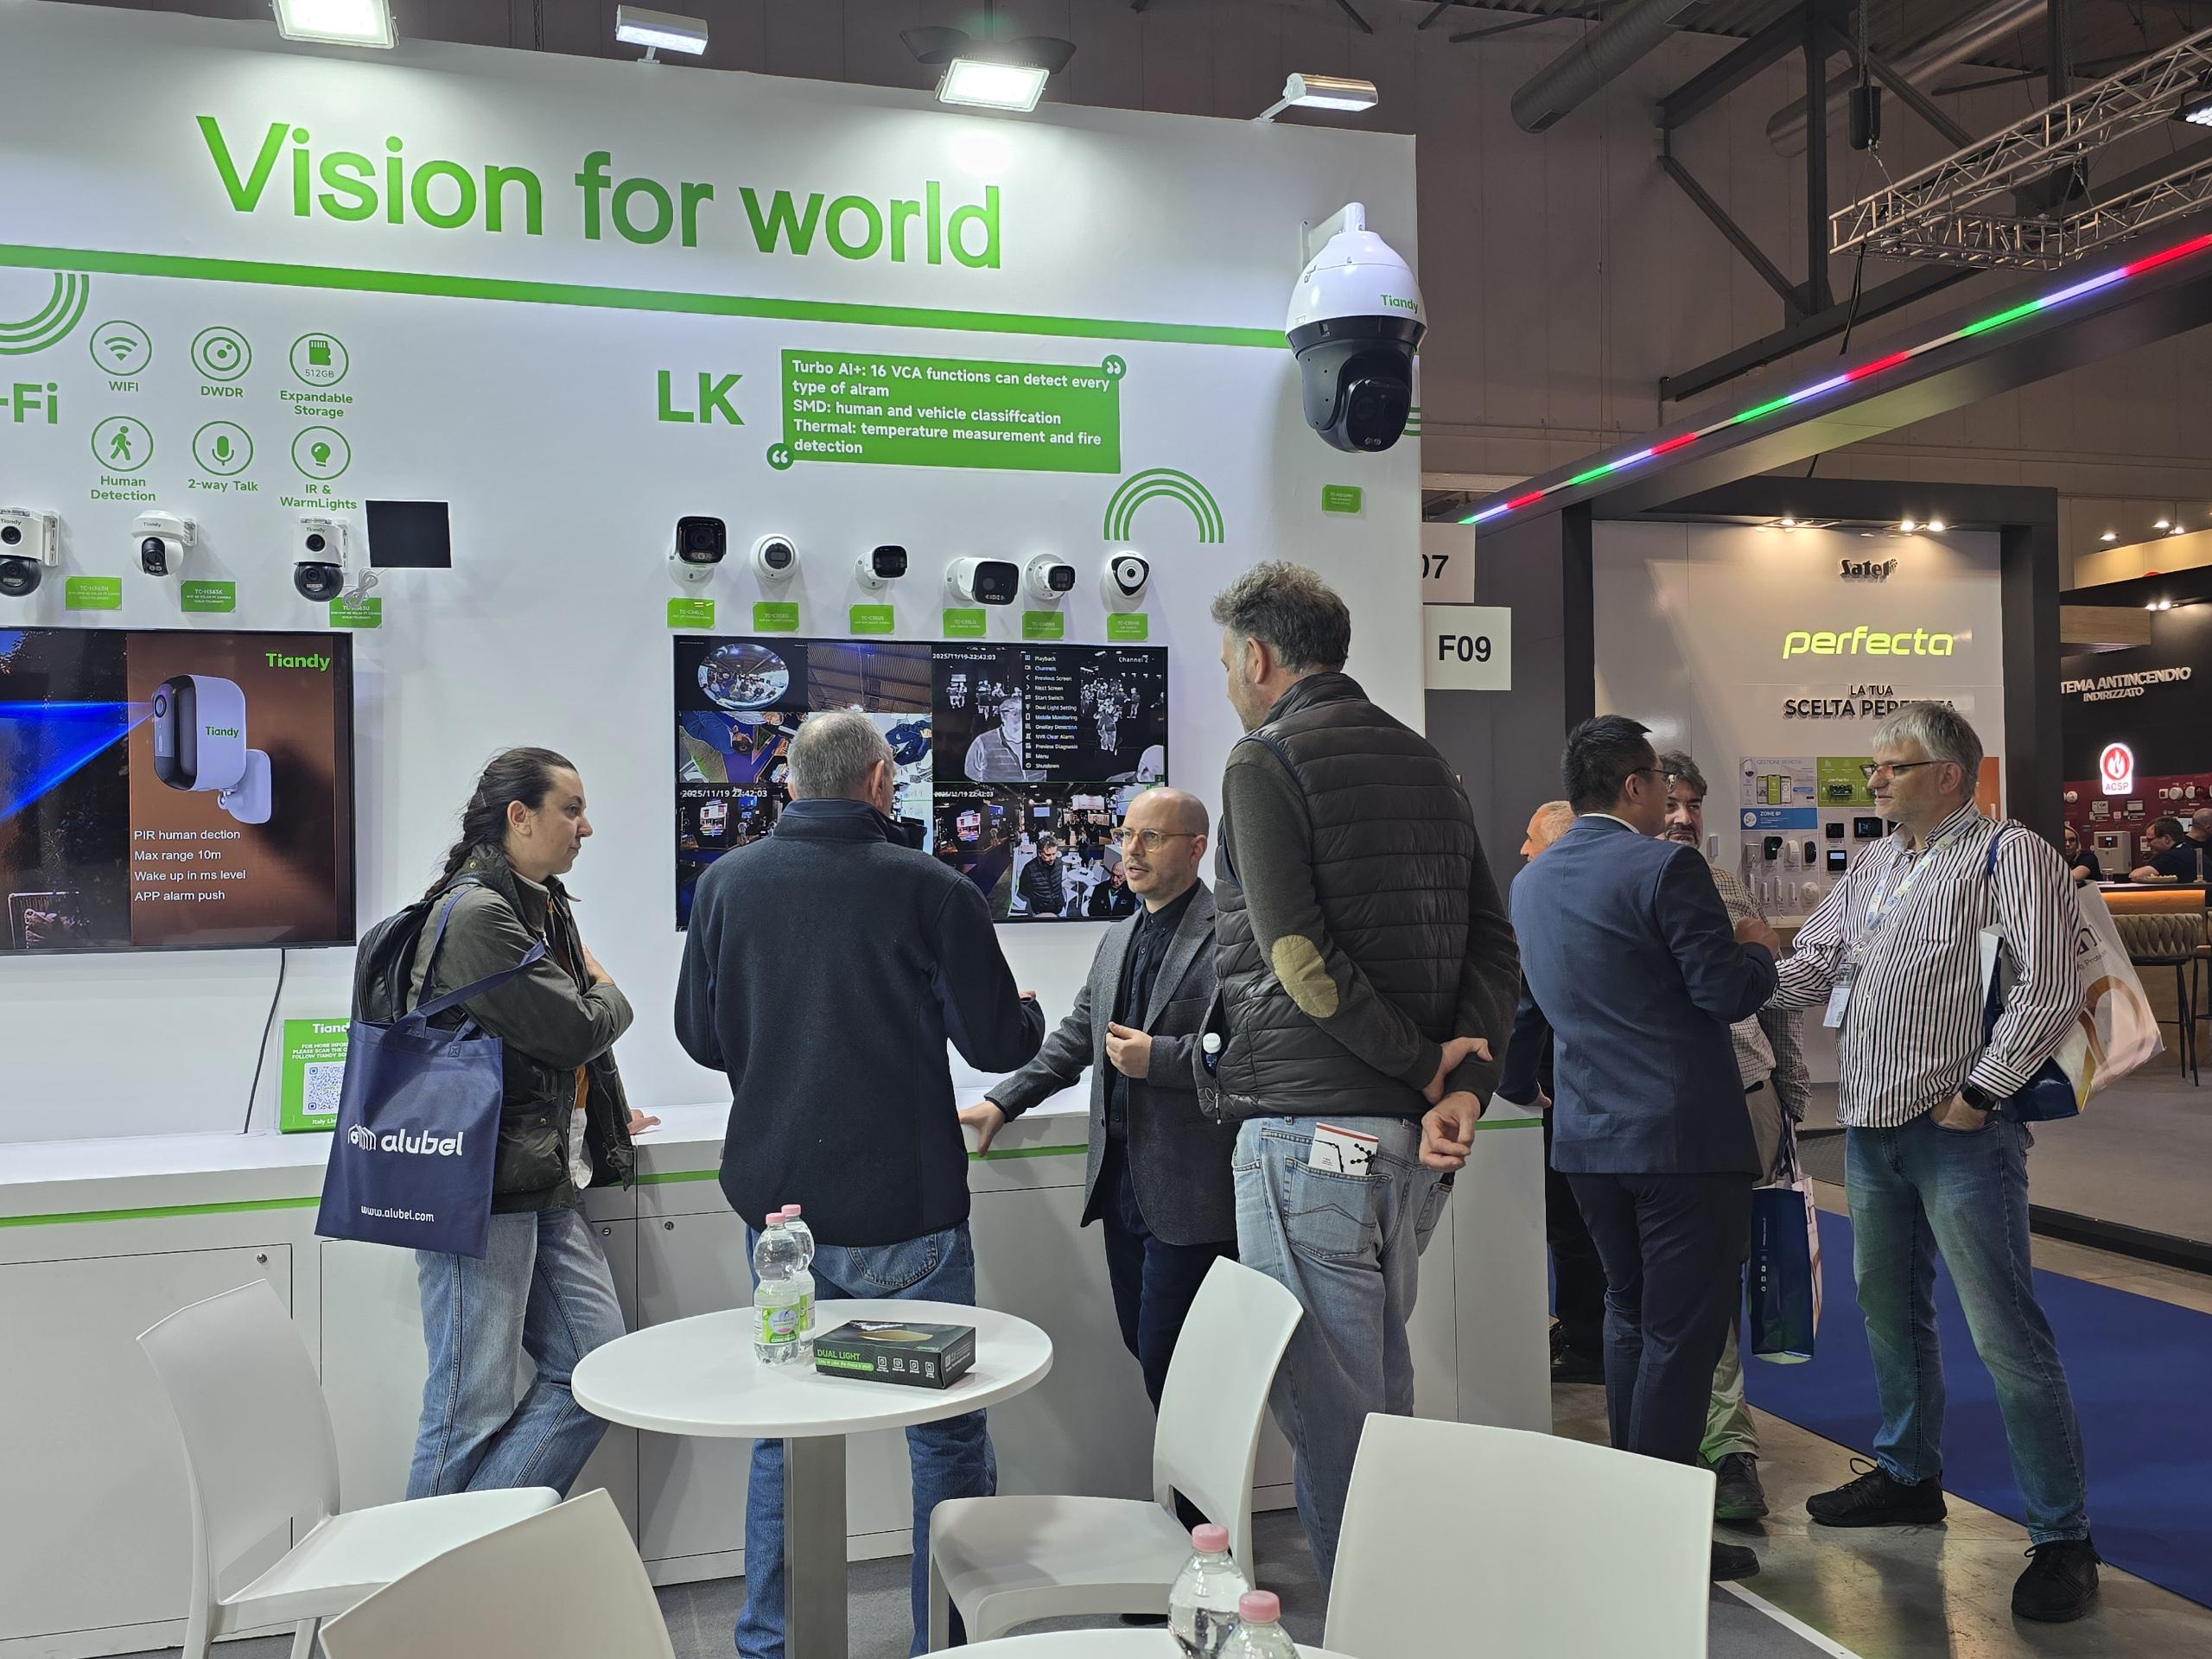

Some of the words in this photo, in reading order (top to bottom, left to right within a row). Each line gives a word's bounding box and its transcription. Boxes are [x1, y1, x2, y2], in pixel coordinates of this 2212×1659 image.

[195, 115, 542, 236] Vision
[575, 150, 714, 248] for
[739, 181, 1001, 269] world
[1380, 295, 1419, 314] Tiandy
[305, 369, 334, 378] 512GB
[792, 359, 834, 374] Turbo
[838, 363, 866, 377] AI+:
[871, 365, 887, 378] 16
[892, 365, 923, 379] VCA
[926, 367, 991, 384] functions
[995, 373, 1020, 385] can
[1024, 373, 1068, 387] detect
[1071, 377, 1109, 392] every
[109, 380, 139, 392] WIFI
[200, 385, 244, 397] DWDR
[792, 379, 825, 396] type
[830, 381, 846, 394] of
[849, 383, 889, 397] alram
[280, 390, 353, 406] Expandable
[658, 370, 745, 426] LK
[294, 405, 345, 420] Storage
[793, 399, 831, 413] SMD:
[836, 401, 883, 416] human
[887, 405, 912, 417] and
[917, 406, 966, 420] vehicle
[970, 408, 1061, 424] classiffcation
[793, 418, 856, 434] Thermal:
[861, 423, 948, 439] temperature
[953, 428, 1046, 443] measurement
[1050, 432, 1074, 444] and
[1078, 433, 1102, 445] fire
[794, 439, 863, 454] detection
[100, 475, 146, 488] Human
[188, 479, 228, 493] 2-way
[233, 480, 259, 492] Talk
[91, 489, 156, 502] Detection
[305, 484, 319, 494] IR
[321, 484, 332, 495] &
[280, 496, 358, 510] WarmLights
[1439, 635, 1491, 662] F09
[1783, 626, 1954, 659] perfecta
[265, 652, 331, 672] Tiandy
[2061, 678, 2095, 694] TEMA
[2097, 666, 2192, 690] ANTINCENDIO
[1850, 685, 1866, 696] LA
[1869, 685, 1894, 696] TUA
[2083, 687, 2145, 702] INDIRIZZATO
[1784, 699, 1855, 716] SCELTA
[205, 726, 239, 739] Tiandy
[2105, 782, 2128, 791] ACSP
[134, 830, 156, 840] PIR
[158, 830, 197, 840] human
[200, 830, 240, 840] dection
[135, 850, 158, 861] Max
[162, 852, 194, 862] range
[198, 850, 221, 860] 10m
[135, 871, 167, 880] Wake
[169, 873, 183, 883] up
[187, 870, 197, 880] in
[220, 869, 246, 880] level
[135, 891, 160, 901] APP
[163, 891, 195, 901] alarm
[198, 890, 226, 904] push
[312, 1022, 350, 1033] Tiand
[380, 1128, 464, 1156] alubel
[360, 1205, 435, 1223] www.alubel.com
[817, 1349, 837, 1357] DUAL
[839, 1351, 861, 1361] LIGHT
